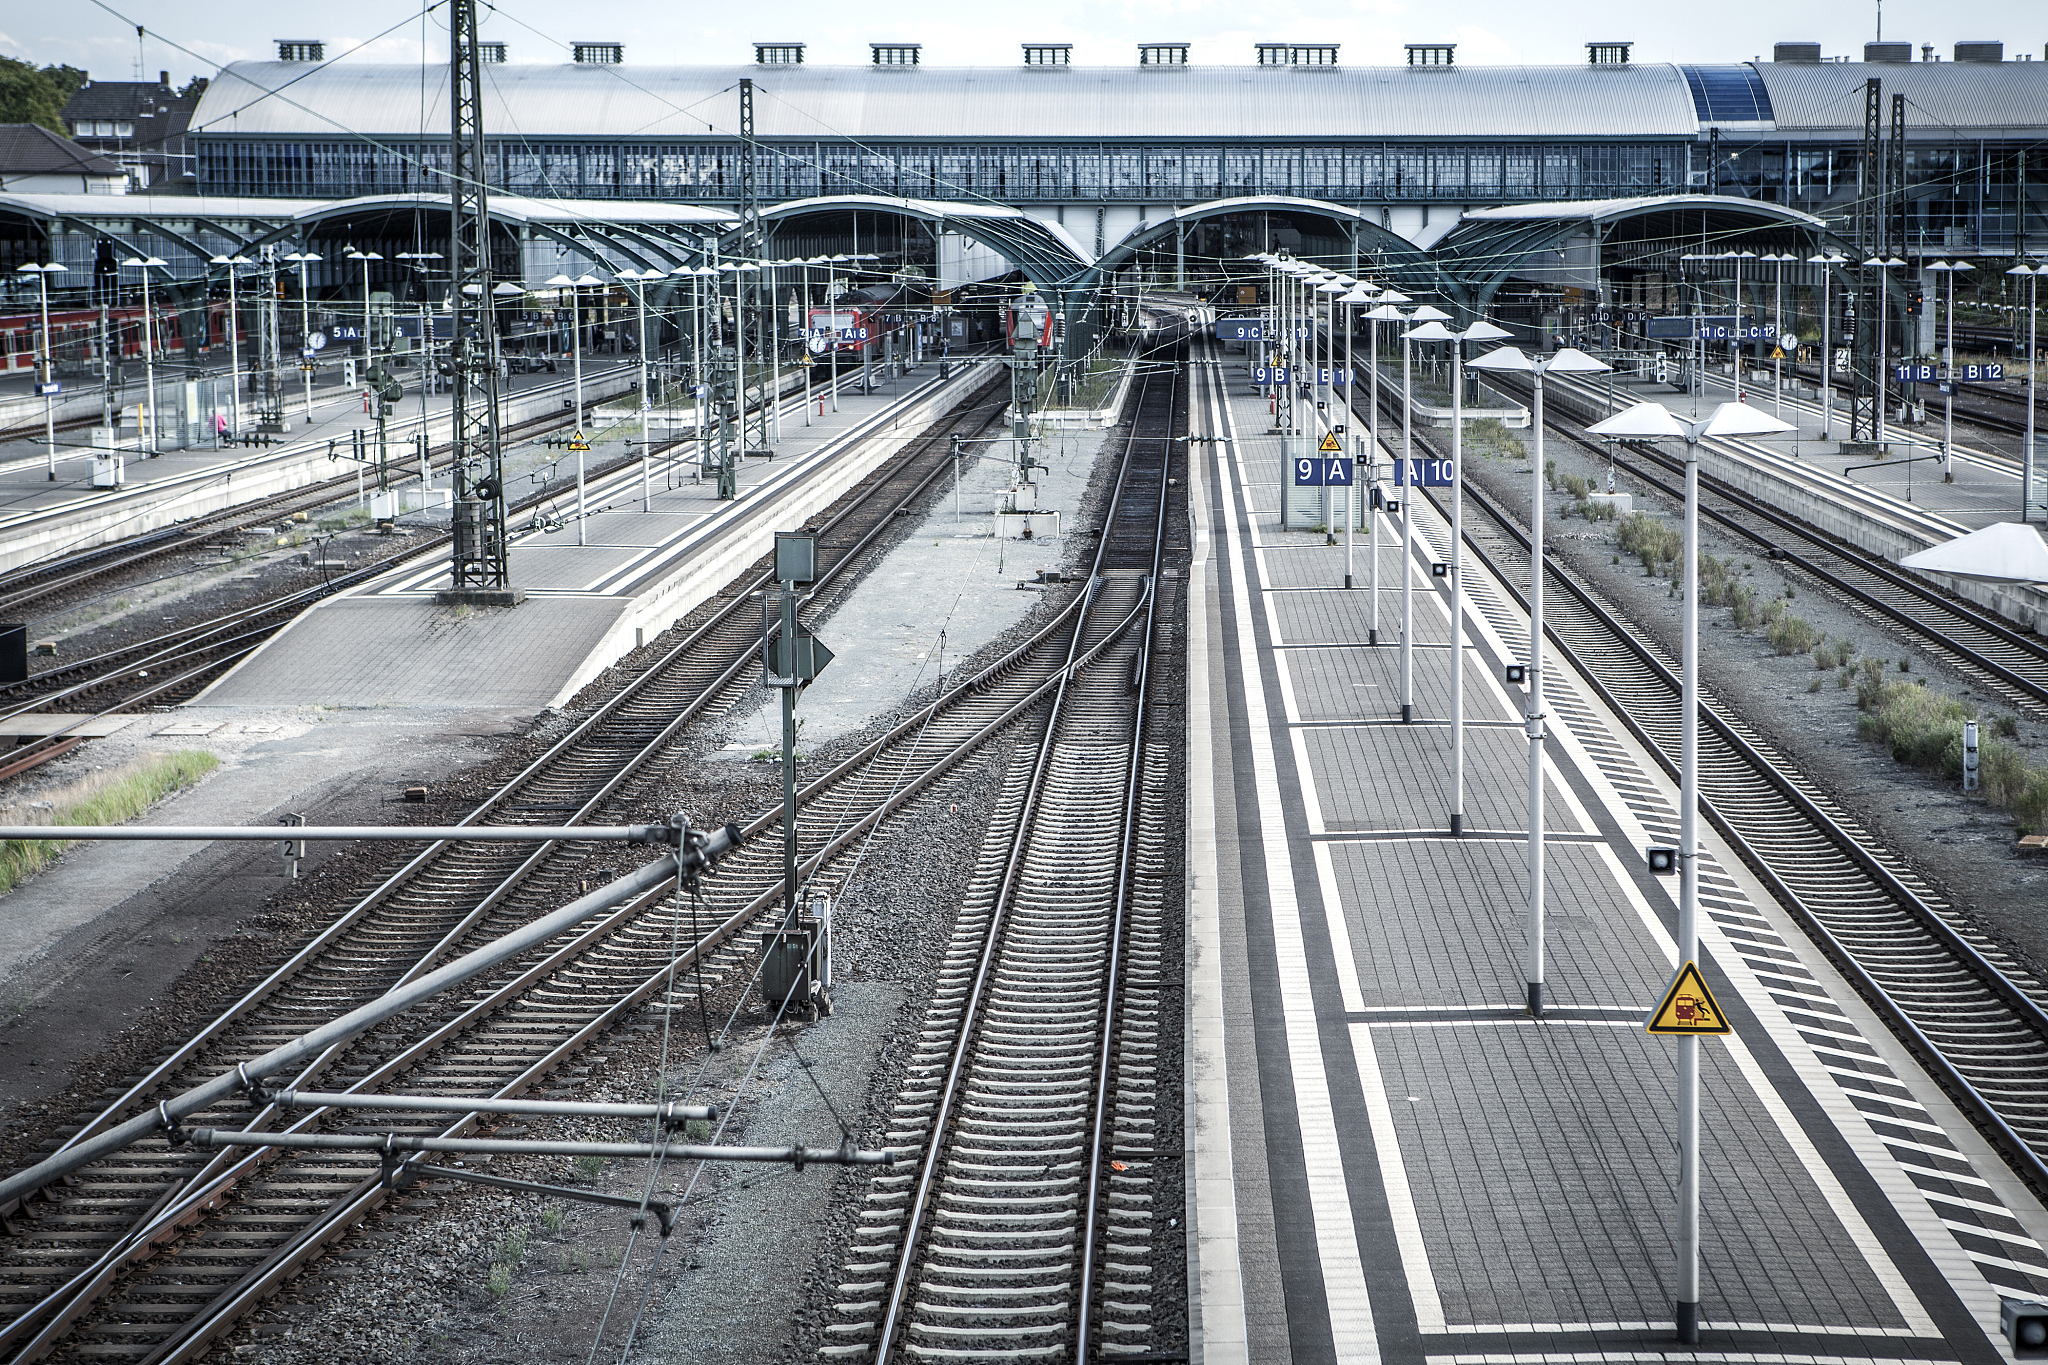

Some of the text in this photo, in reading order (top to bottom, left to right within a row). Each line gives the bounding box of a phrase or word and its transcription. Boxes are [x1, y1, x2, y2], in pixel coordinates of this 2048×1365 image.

[522, 312, 539, 320] 5 B
[558, 312, 574, 320] B 6
[885, 314, 890, 322] 7
[1591, 312, 1609, 321] 11 D
[1628, 312, 1646, 321] D 12
[333, 327, 356, 338] 5 A
[395, 327, 403, 338] 6
[813, 328, 821, 338] A
[845, 328, 867, 338] A 8
[1237, 327, 1259, 338] 9 C
[1700, 327, 1725, 338] 11 C
[1750, 327, 1775, 338] C 12
[1256, 368, 1285, 382] 9 B
[1897, 366, 1931, 379] 11 B
[1968, 365, 2001, 379] B 12
[1298, 459, 1345, 480] 9 A
[1431, 460, 1454, 481] 10
[284, 840, 294, 856] 2
